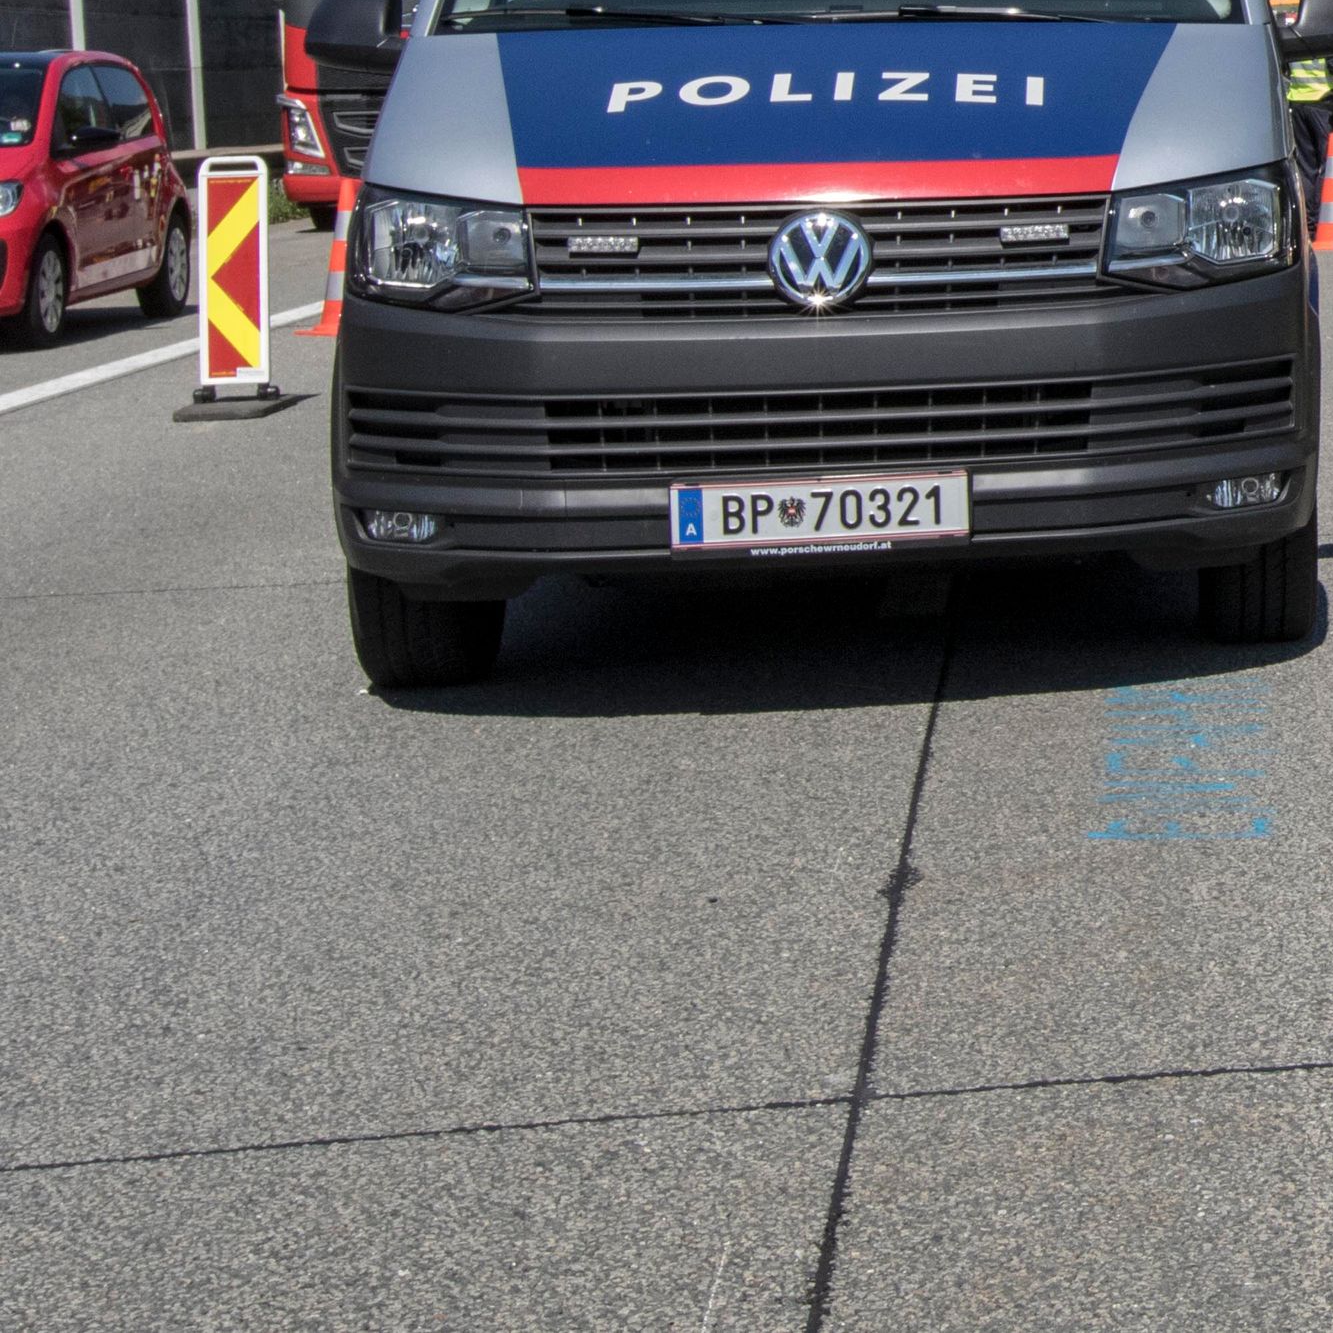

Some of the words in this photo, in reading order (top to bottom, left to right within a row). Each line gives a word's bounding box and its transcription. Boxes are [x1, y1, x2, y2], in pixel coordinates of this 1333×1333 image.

[606, 71, 1045, 113] POLIZEI
[773, 212, 870, 306] VW
[685, 522, 697, 536] A
[722, 493, 774, 535] BP
[810, 484, 941, 532] 70321
[750, 540, 892, 556] www.porschewrneudorf.at
